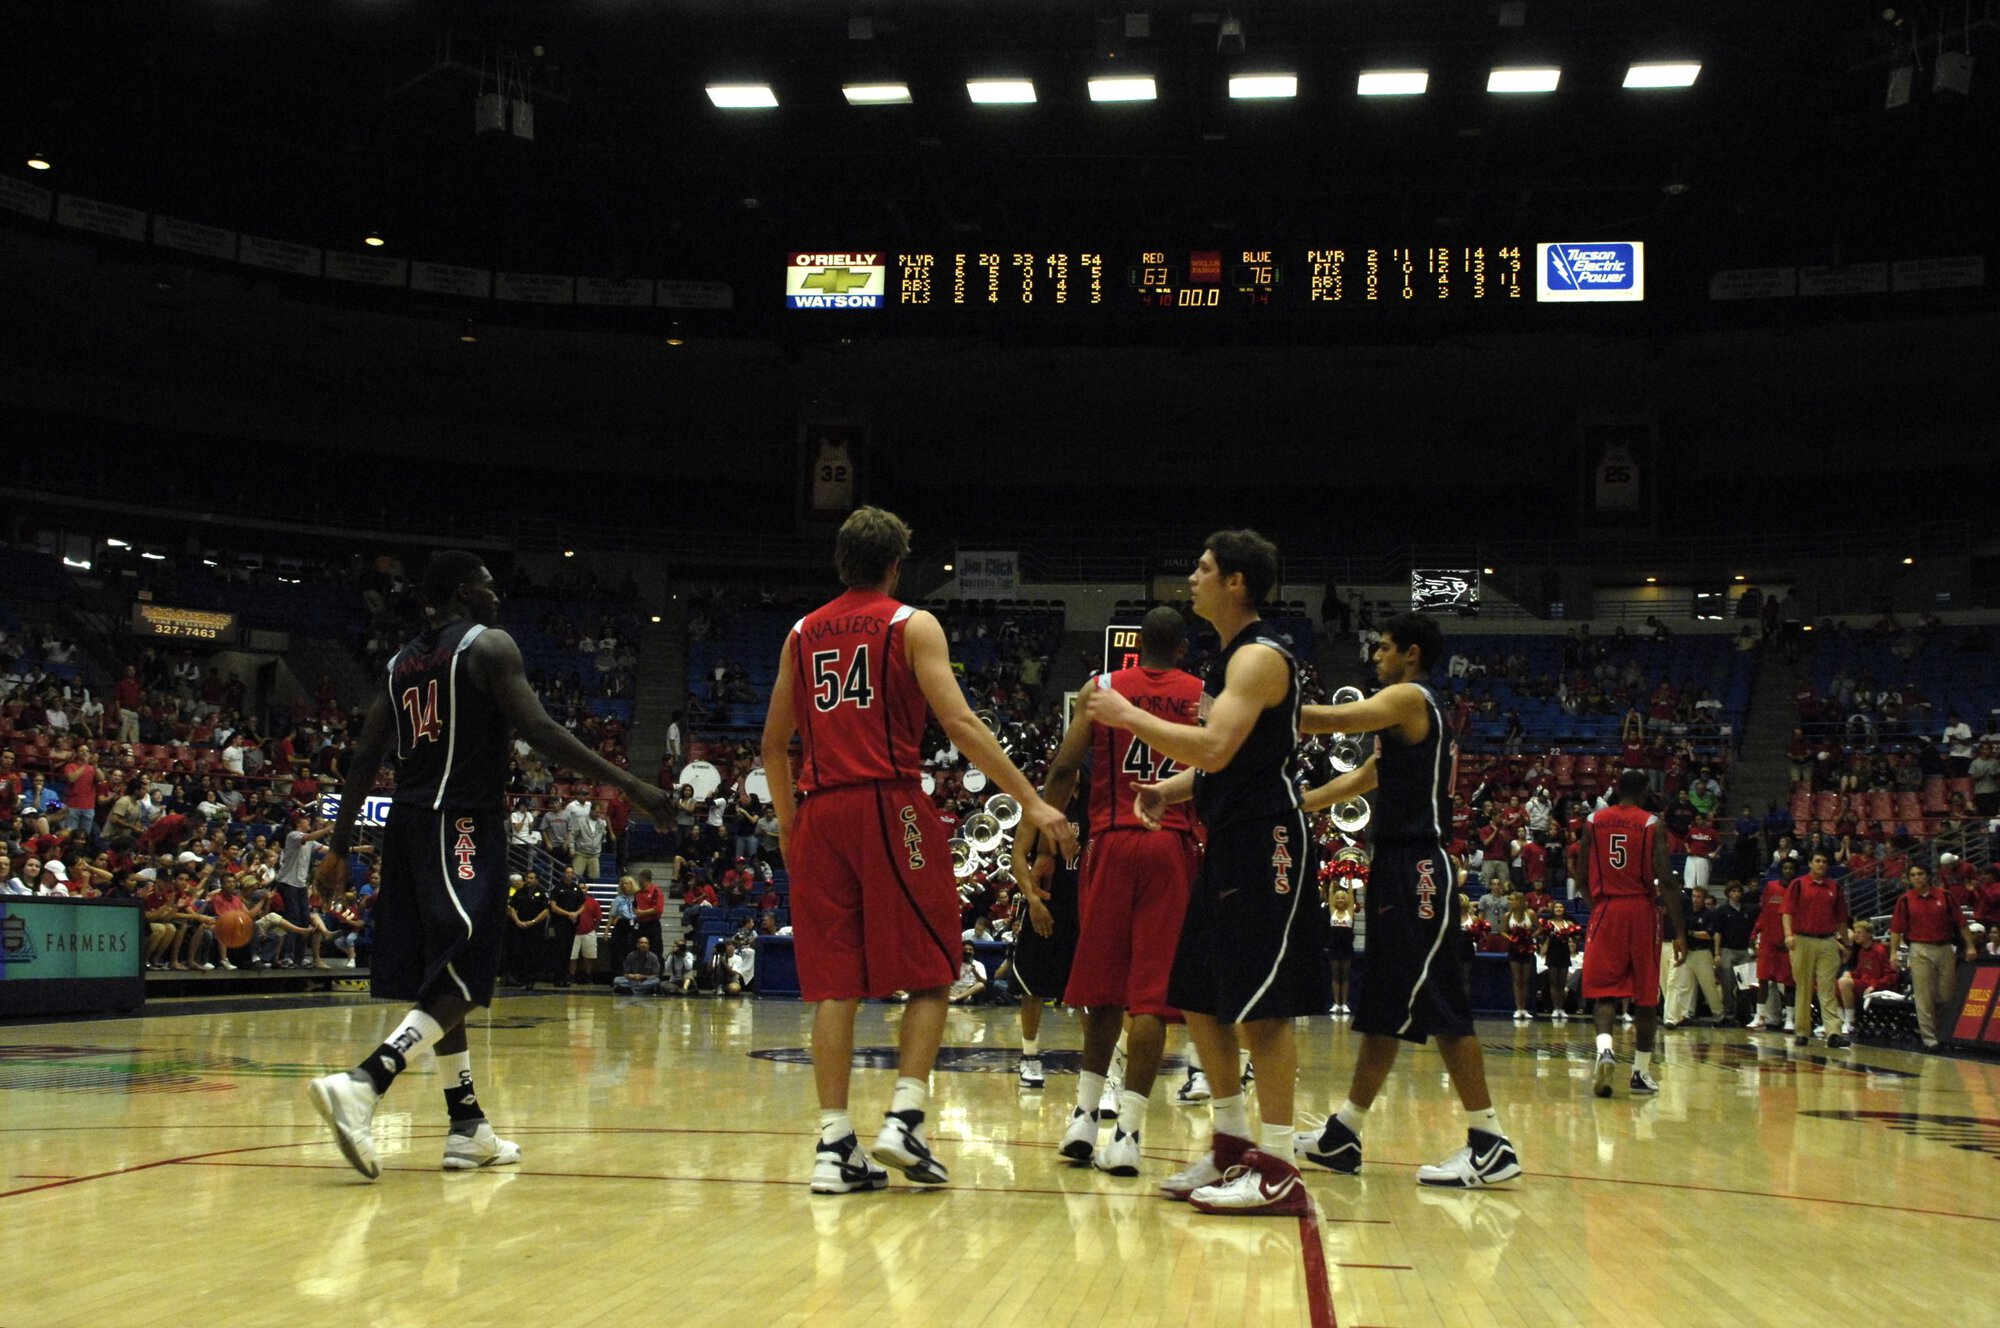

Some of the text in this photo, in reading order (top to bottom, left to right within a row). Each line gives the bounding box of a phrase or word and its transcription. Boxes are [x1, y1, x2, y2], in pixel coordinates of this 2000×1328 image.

[796, 254, 877, 266] O'RIELLY
[899, 254, 1102, 266] PLYR 5 20 33 42 54
[1142, 252, 1164, 264] RED
[1242, 251, 1272, 263] BLUE
[1307, 247, 1520, 263] PLYR 2 11 12 14 44
[1567, 249, 1616, 260] Tucson
[904, 267, 930, 279] PTS
[989, 266, 999, 278] 5
[1023, 267, 1033, 278] 0
[1049, 267, 1067, 278] 12
[1091, 267, 1101, 278] 5
[1314, 263, 1341, 275] PTS
[1429, 261, 1449, 273] 12
[1465, 260, 1485, 272] 13
[1510, 260, 1520, 272] 9
[1572, 260, 1626, 272] Electric
[1143, 268, 1168, 285] 63
[1250, 267, 1273, 284] 76
[1312, 273, 1517, 288] RBS 0 1 4 9 11
[1577, 271, 1627, 283] Power
[902, 279, 1101, 291] RBS 2 2 0 4 4
[901, 291, 1101, 303] FLS 2 4 0 5 3
[1178, 288, 1220, 306] 00.0
[1312, 286, 1520, 301] FLS 2 0 3 3 2
[795, 296, 876, 307] WATSON
[821, 465, 847, 482] 32
[960, 557, 1014, 577] Jim Click
[155, 624, 217, 639] 327-7463
[804, 616, 885, 642] WALTERS
[812, 643, 875, 713] 54
[402, 678, 444, 750] 14
[899, 805, 926, 871] CATS
[454, 817, 477, 881] CATS
[1609, 833, 1628, 870] 5
[1271, 825, 1293, 895] CATS
[1415, 859, 1437, 920] CATS
[46, 933, 127, 953] FARMERS
